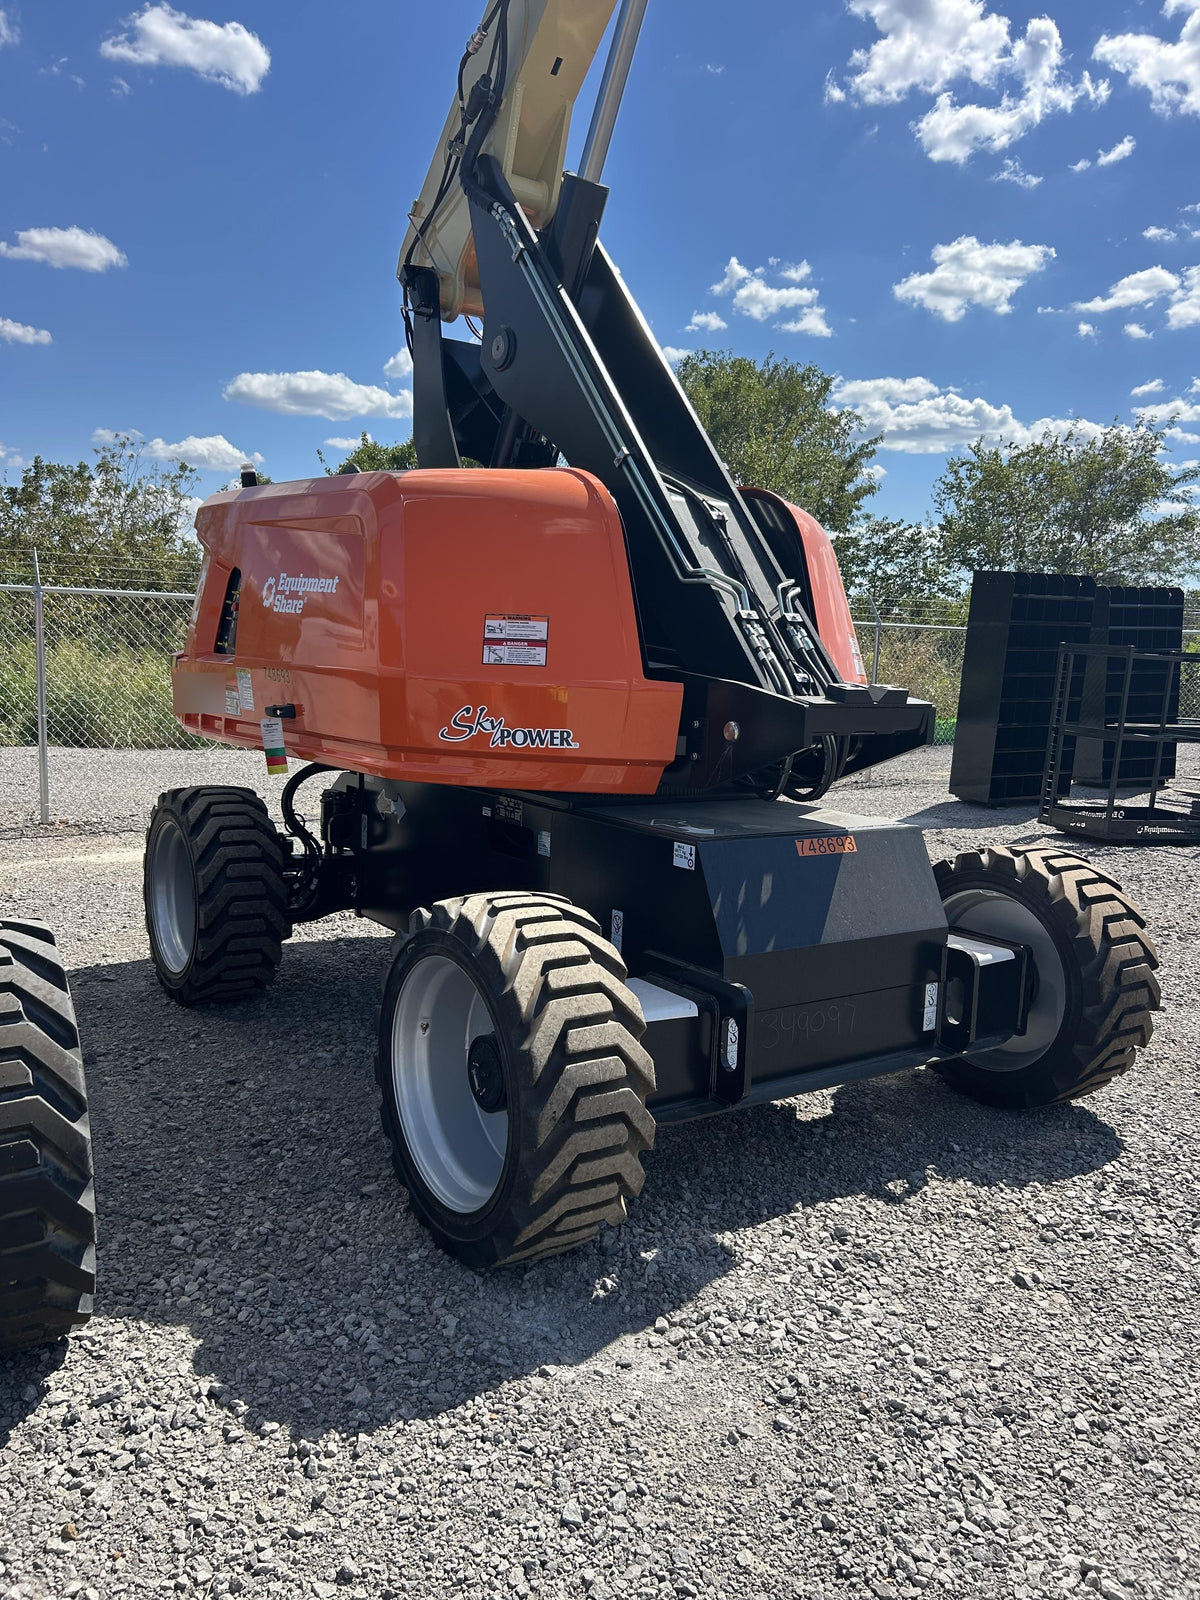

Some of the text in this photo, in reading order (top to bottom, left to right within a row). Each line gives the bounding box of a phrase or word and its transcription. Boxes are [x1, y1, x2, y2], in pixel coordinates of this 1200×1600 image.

[277, 572, 339, 596] Equipment
[273, 595, 304, 614] Share
[262, 666, 290, 684] 748693
[439, 705, 574, 748] Sky POWER
[797, 836, 855, 855] 748693
